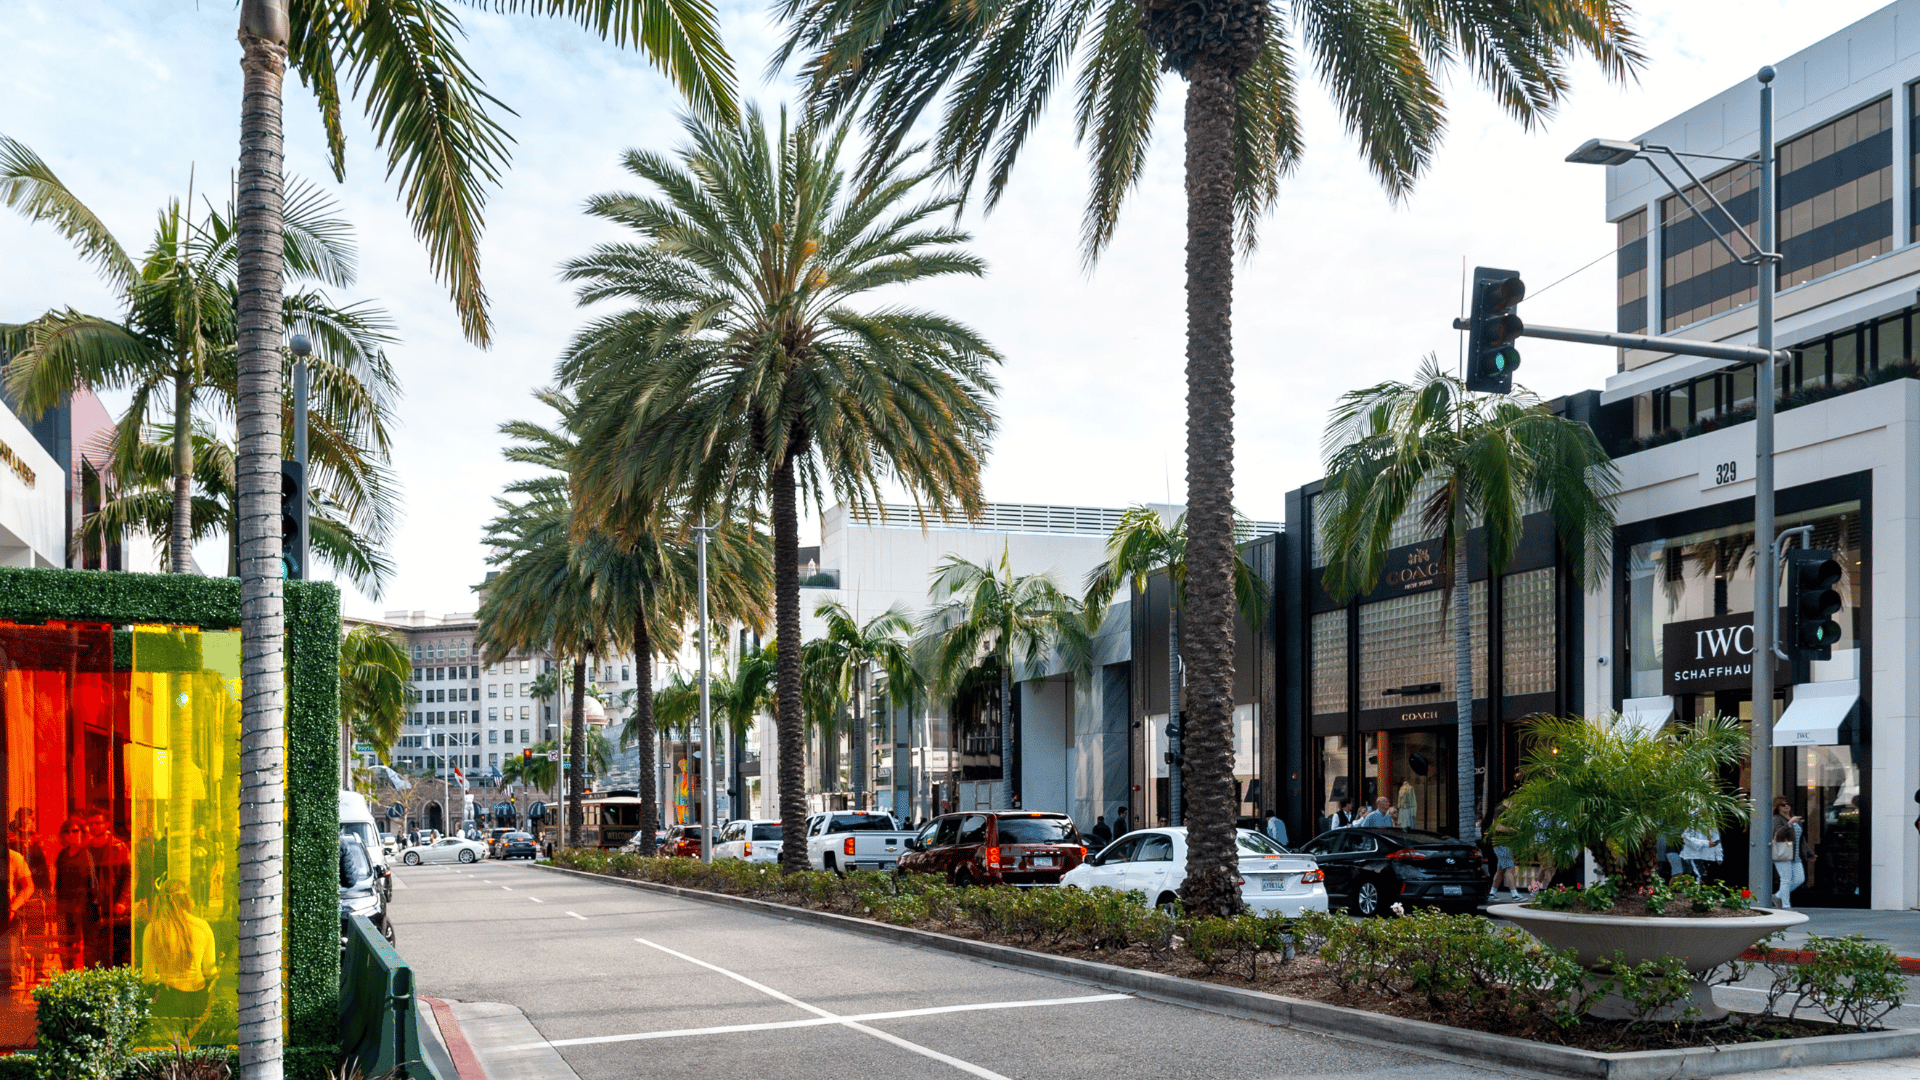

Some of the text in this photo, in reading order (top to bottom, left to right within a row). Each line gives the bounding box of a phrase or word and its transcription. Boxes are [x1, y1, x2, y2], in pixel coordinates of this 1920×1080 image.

[1716, 461, 1737, 485] 329
[1695, 624, 1754, 660] IWC
[1674, 663, 1752, 681] SCHAFFHAU
[1401, 711, 1438, 721] COACH
